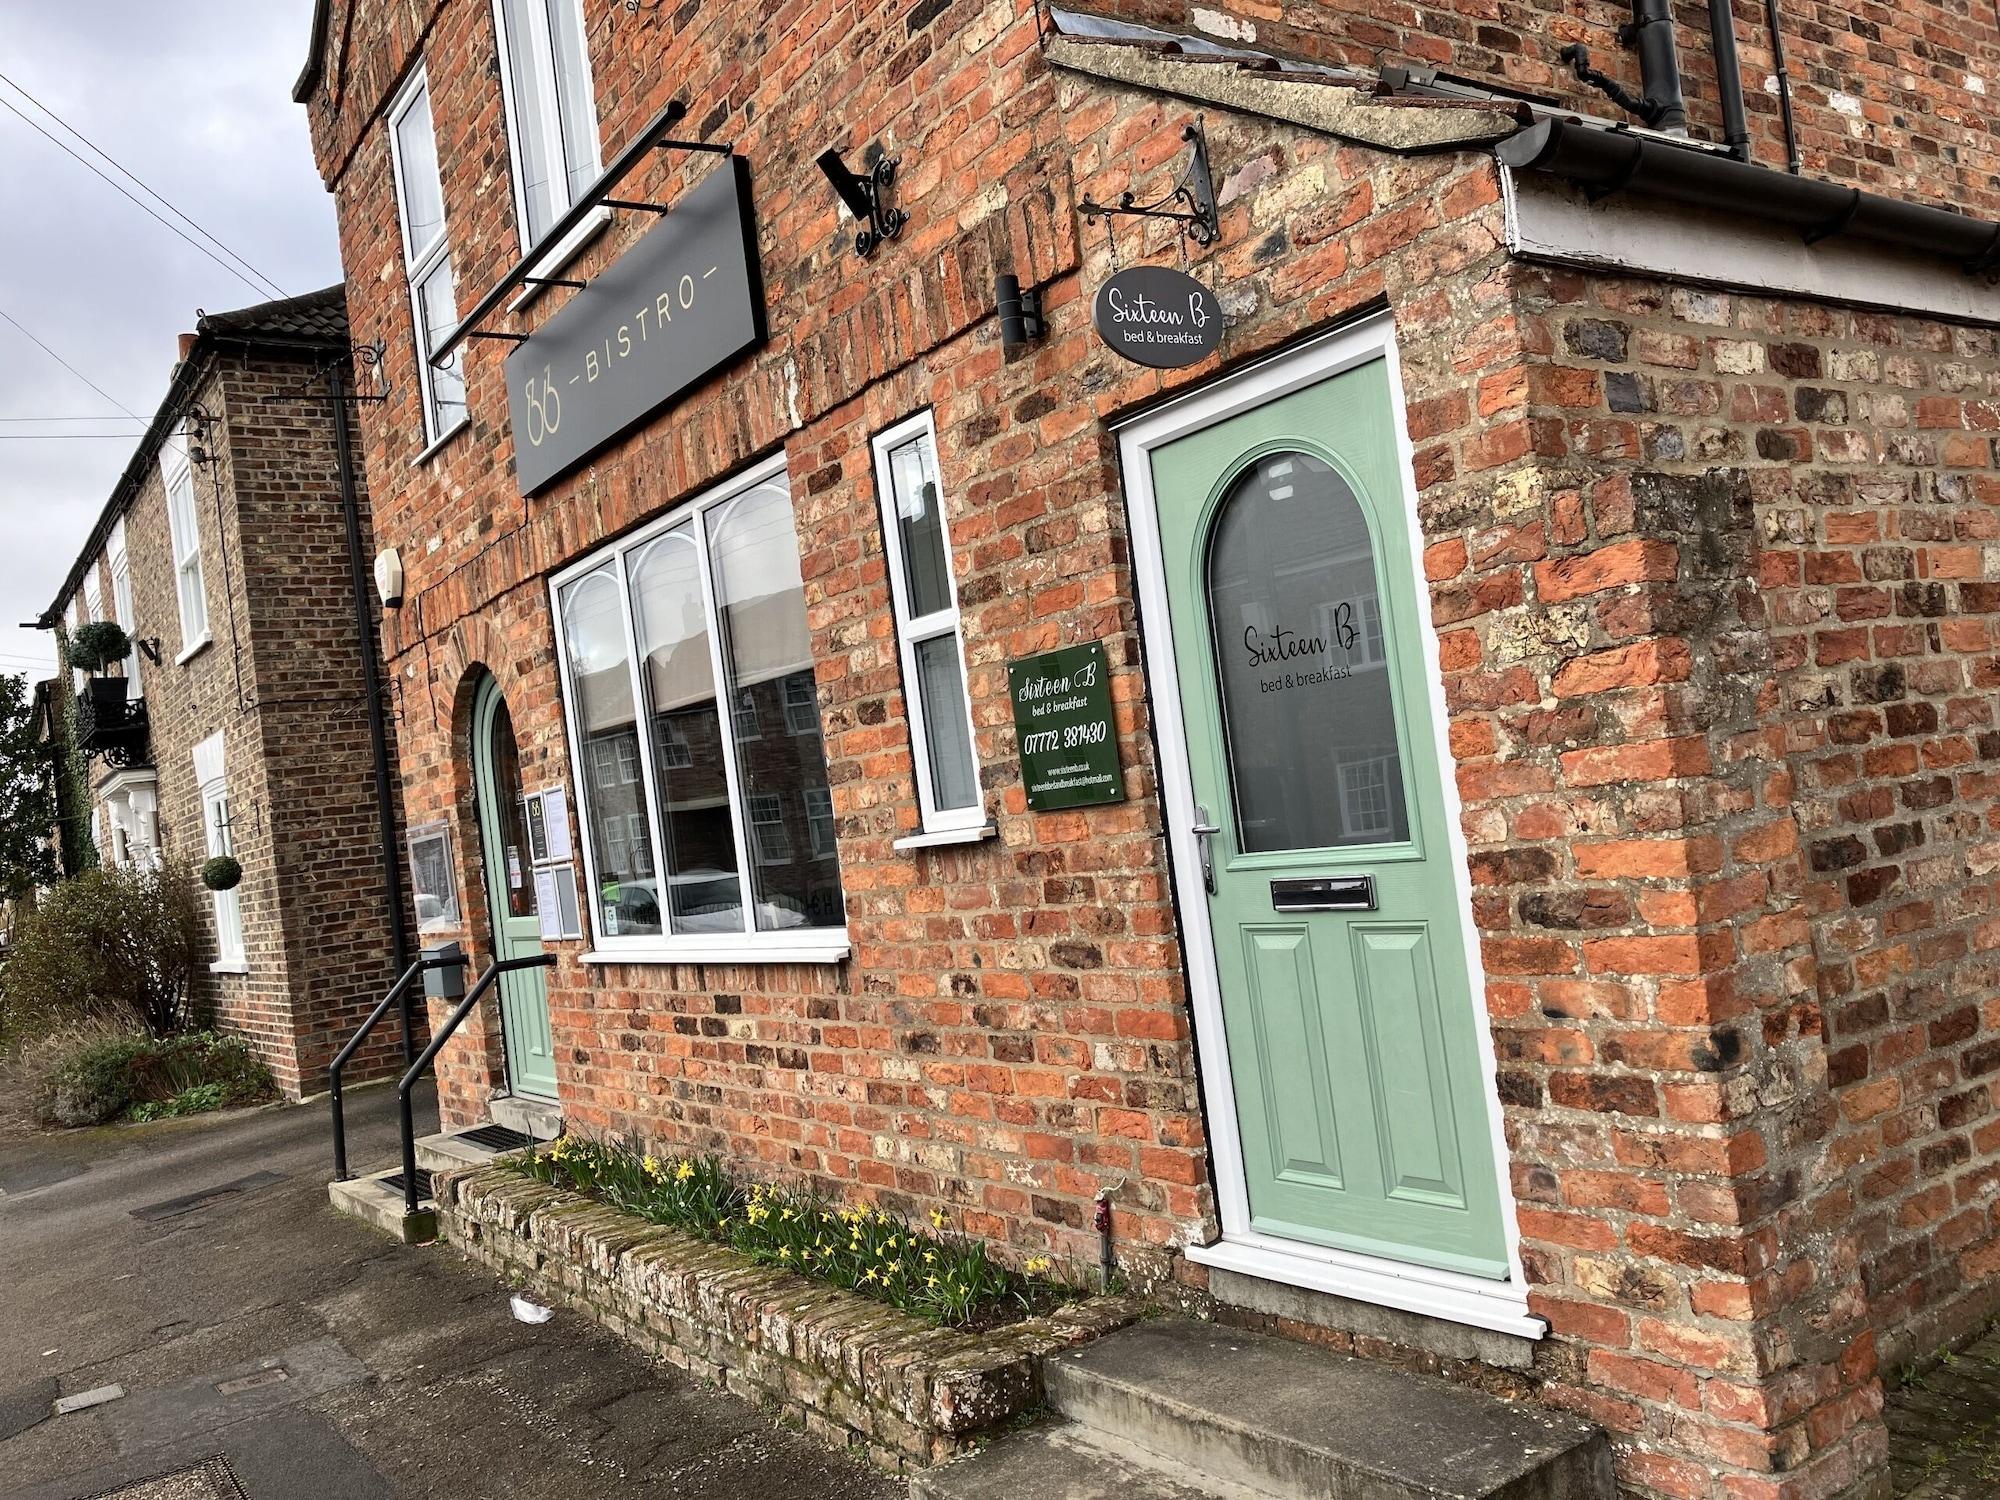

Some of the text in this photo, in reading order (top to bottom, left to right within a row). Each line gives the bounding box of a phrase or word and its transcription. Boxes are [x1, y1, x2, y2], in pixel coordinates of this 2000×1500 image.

[1108, 287, 1211, 328] Sixteen B
[1123, 330, 1203, 345] bed & breakfast
[1244, 602, 1360, 668] Sixteen B
[1018, 661, 1097, 703] Sixteen B
[1260, 664, 1353, 693] bed & breakfast
[1032, 696, 1088, 717] bed & breakfast
[1024, 720, 1107, 755] 07772 381430
